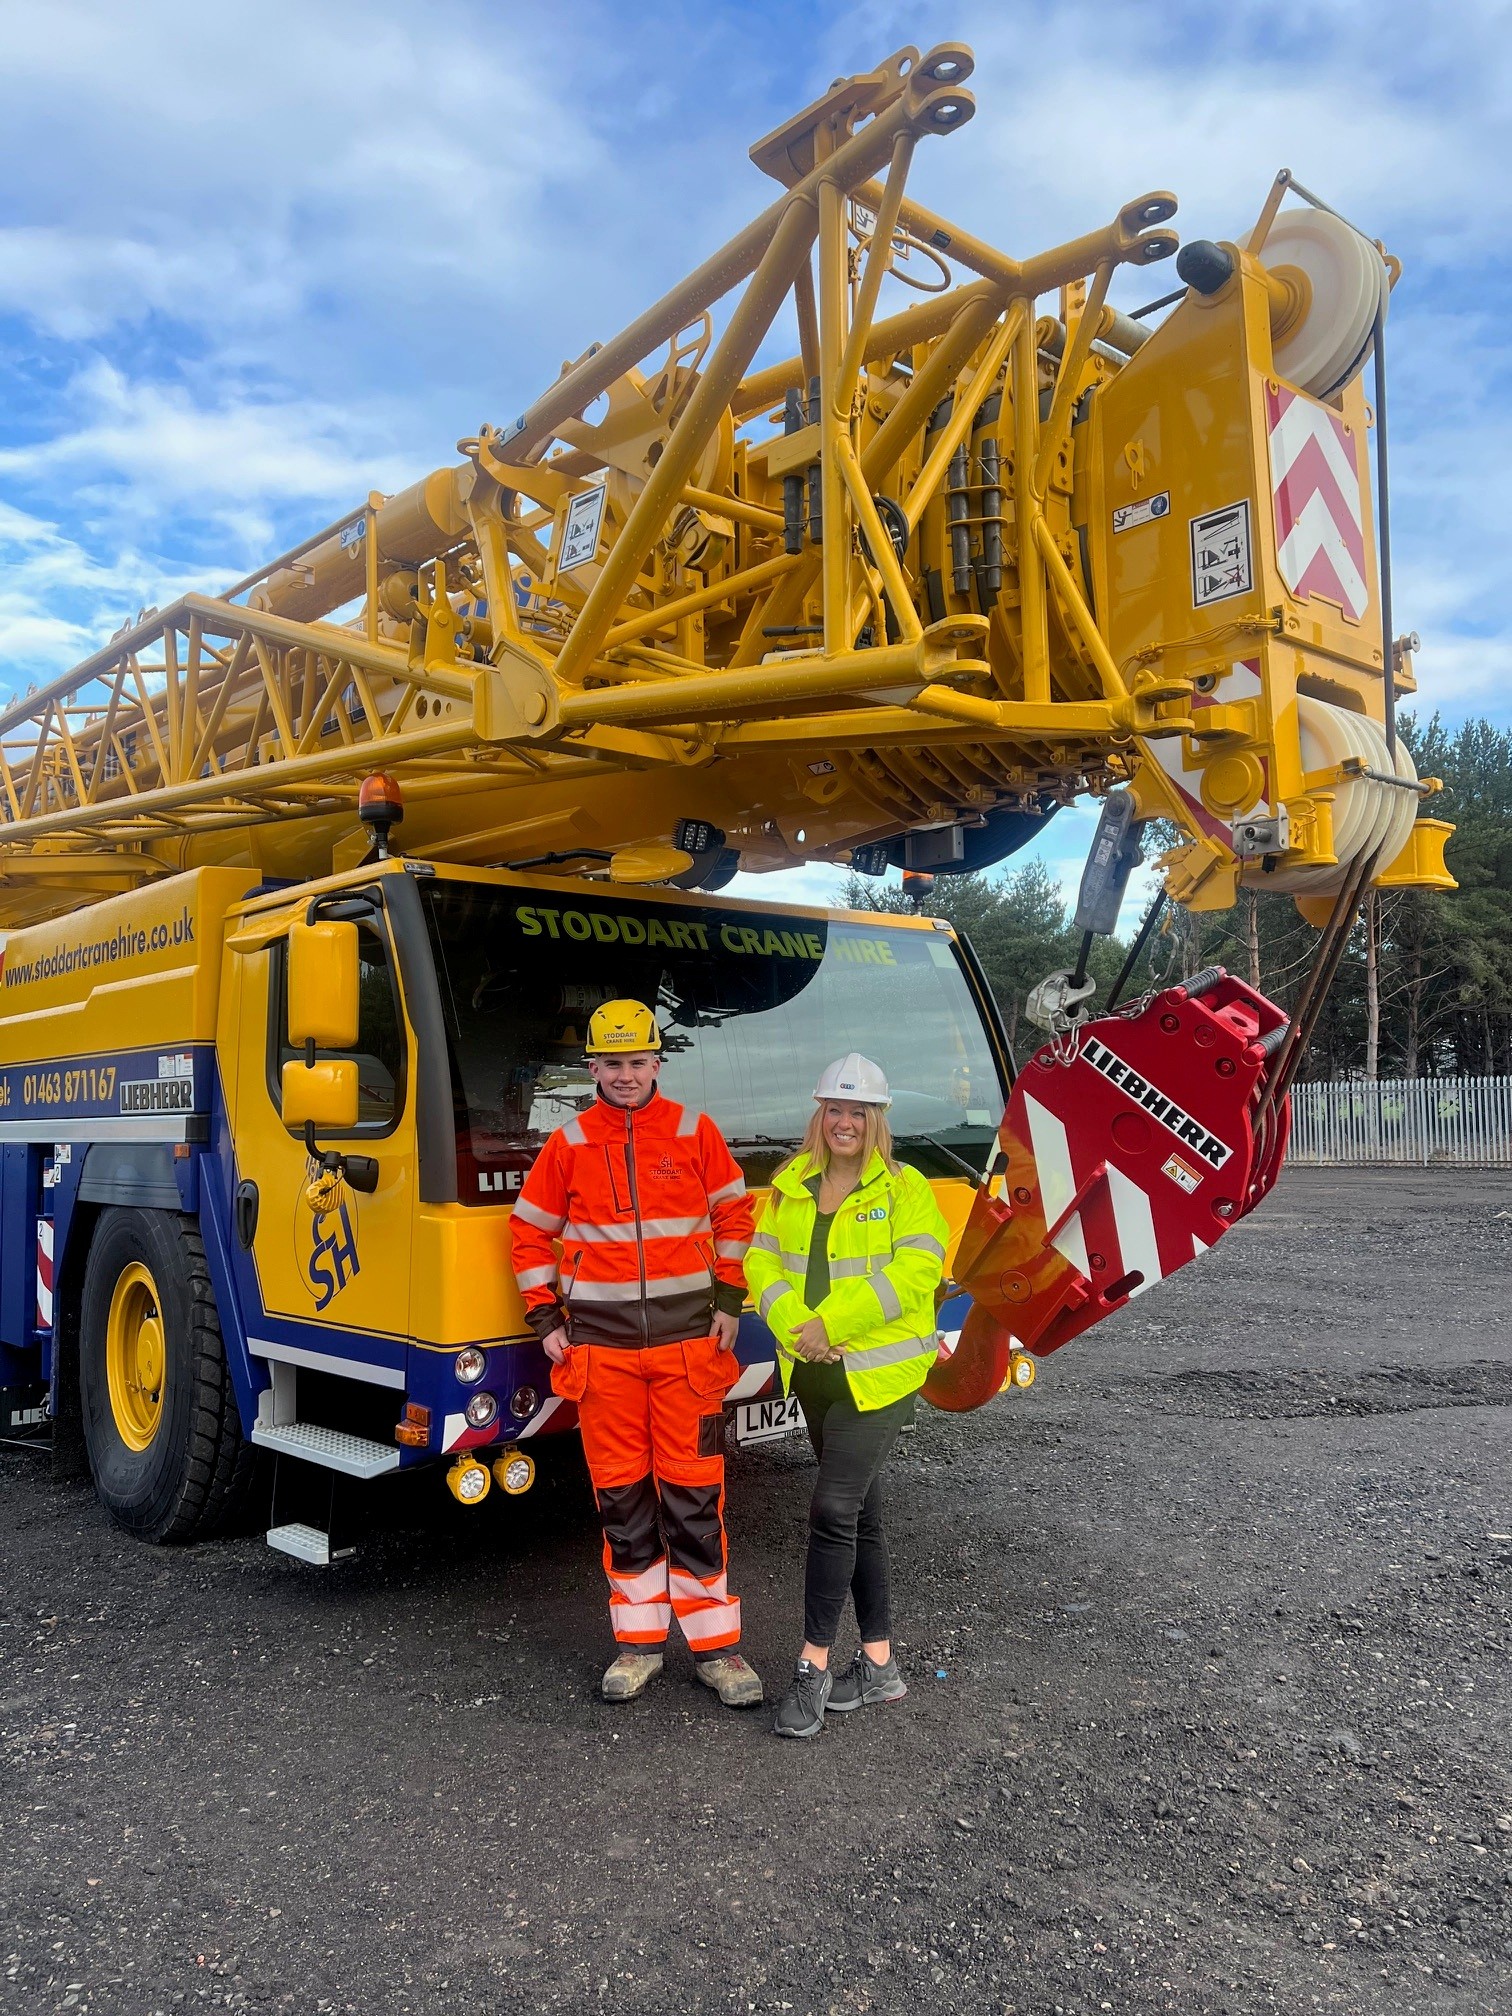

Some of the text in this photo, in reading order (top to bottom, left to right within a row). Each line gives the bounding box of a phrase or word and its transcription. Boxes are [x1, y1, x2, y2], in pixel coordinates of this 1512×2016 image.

[5, 906, 195, 988] www.stoddartcranehire.co.uk
[516, 907, 898, 966] STODDART CRANE HIRE
[23, 1072, 61, 1105] 01463
[64, 1067, 117, 1101] 871167
[121, 1081, 192, 1111] LIEBHERR
[1082, 1039, 1226, 1167] LIEBHERR
[746, 1398, 799, 1431] LN24
